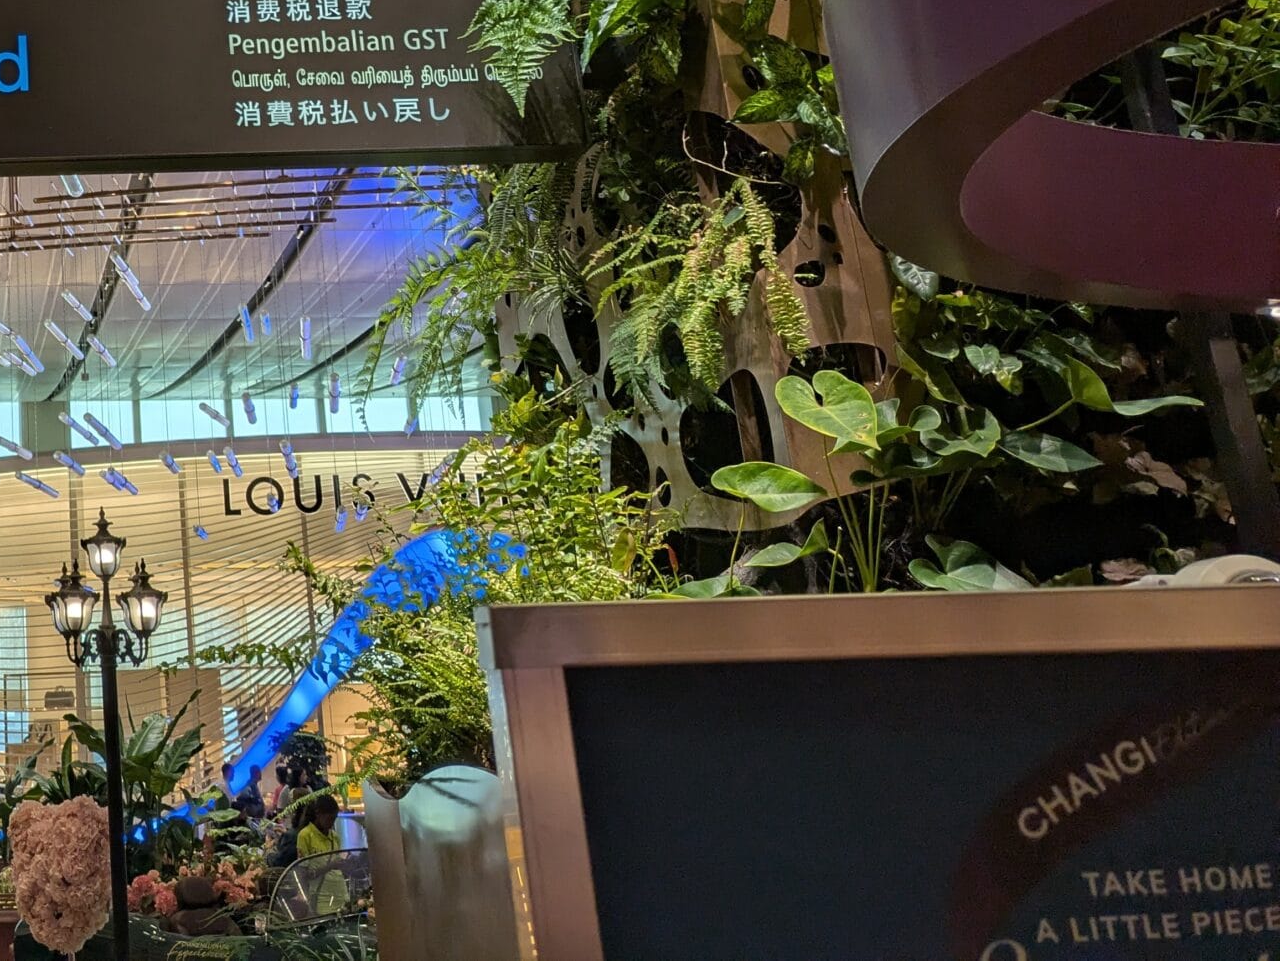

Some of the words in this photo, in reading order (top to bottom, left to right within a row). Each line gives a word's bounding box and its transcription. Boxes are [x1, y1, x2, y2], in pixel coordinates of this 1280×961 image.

[228, 31, 395, 60] Pengembalian
[404, 28, 449, 50] GST
[235, 97, 451, 127] 消費税払い戻し
[223, 473, 379, 517] LOUIS
[1017, 737, 1157, 839] CHANGI
[1081, 870, 1169, 898] TAKE
[1177, 863, 1274, 894] HOME
[1036, 918, 1059, 944] A
[1069, 912, 1182, 944] LITTLE
[1191, 906, 1280, 937] PIECE
